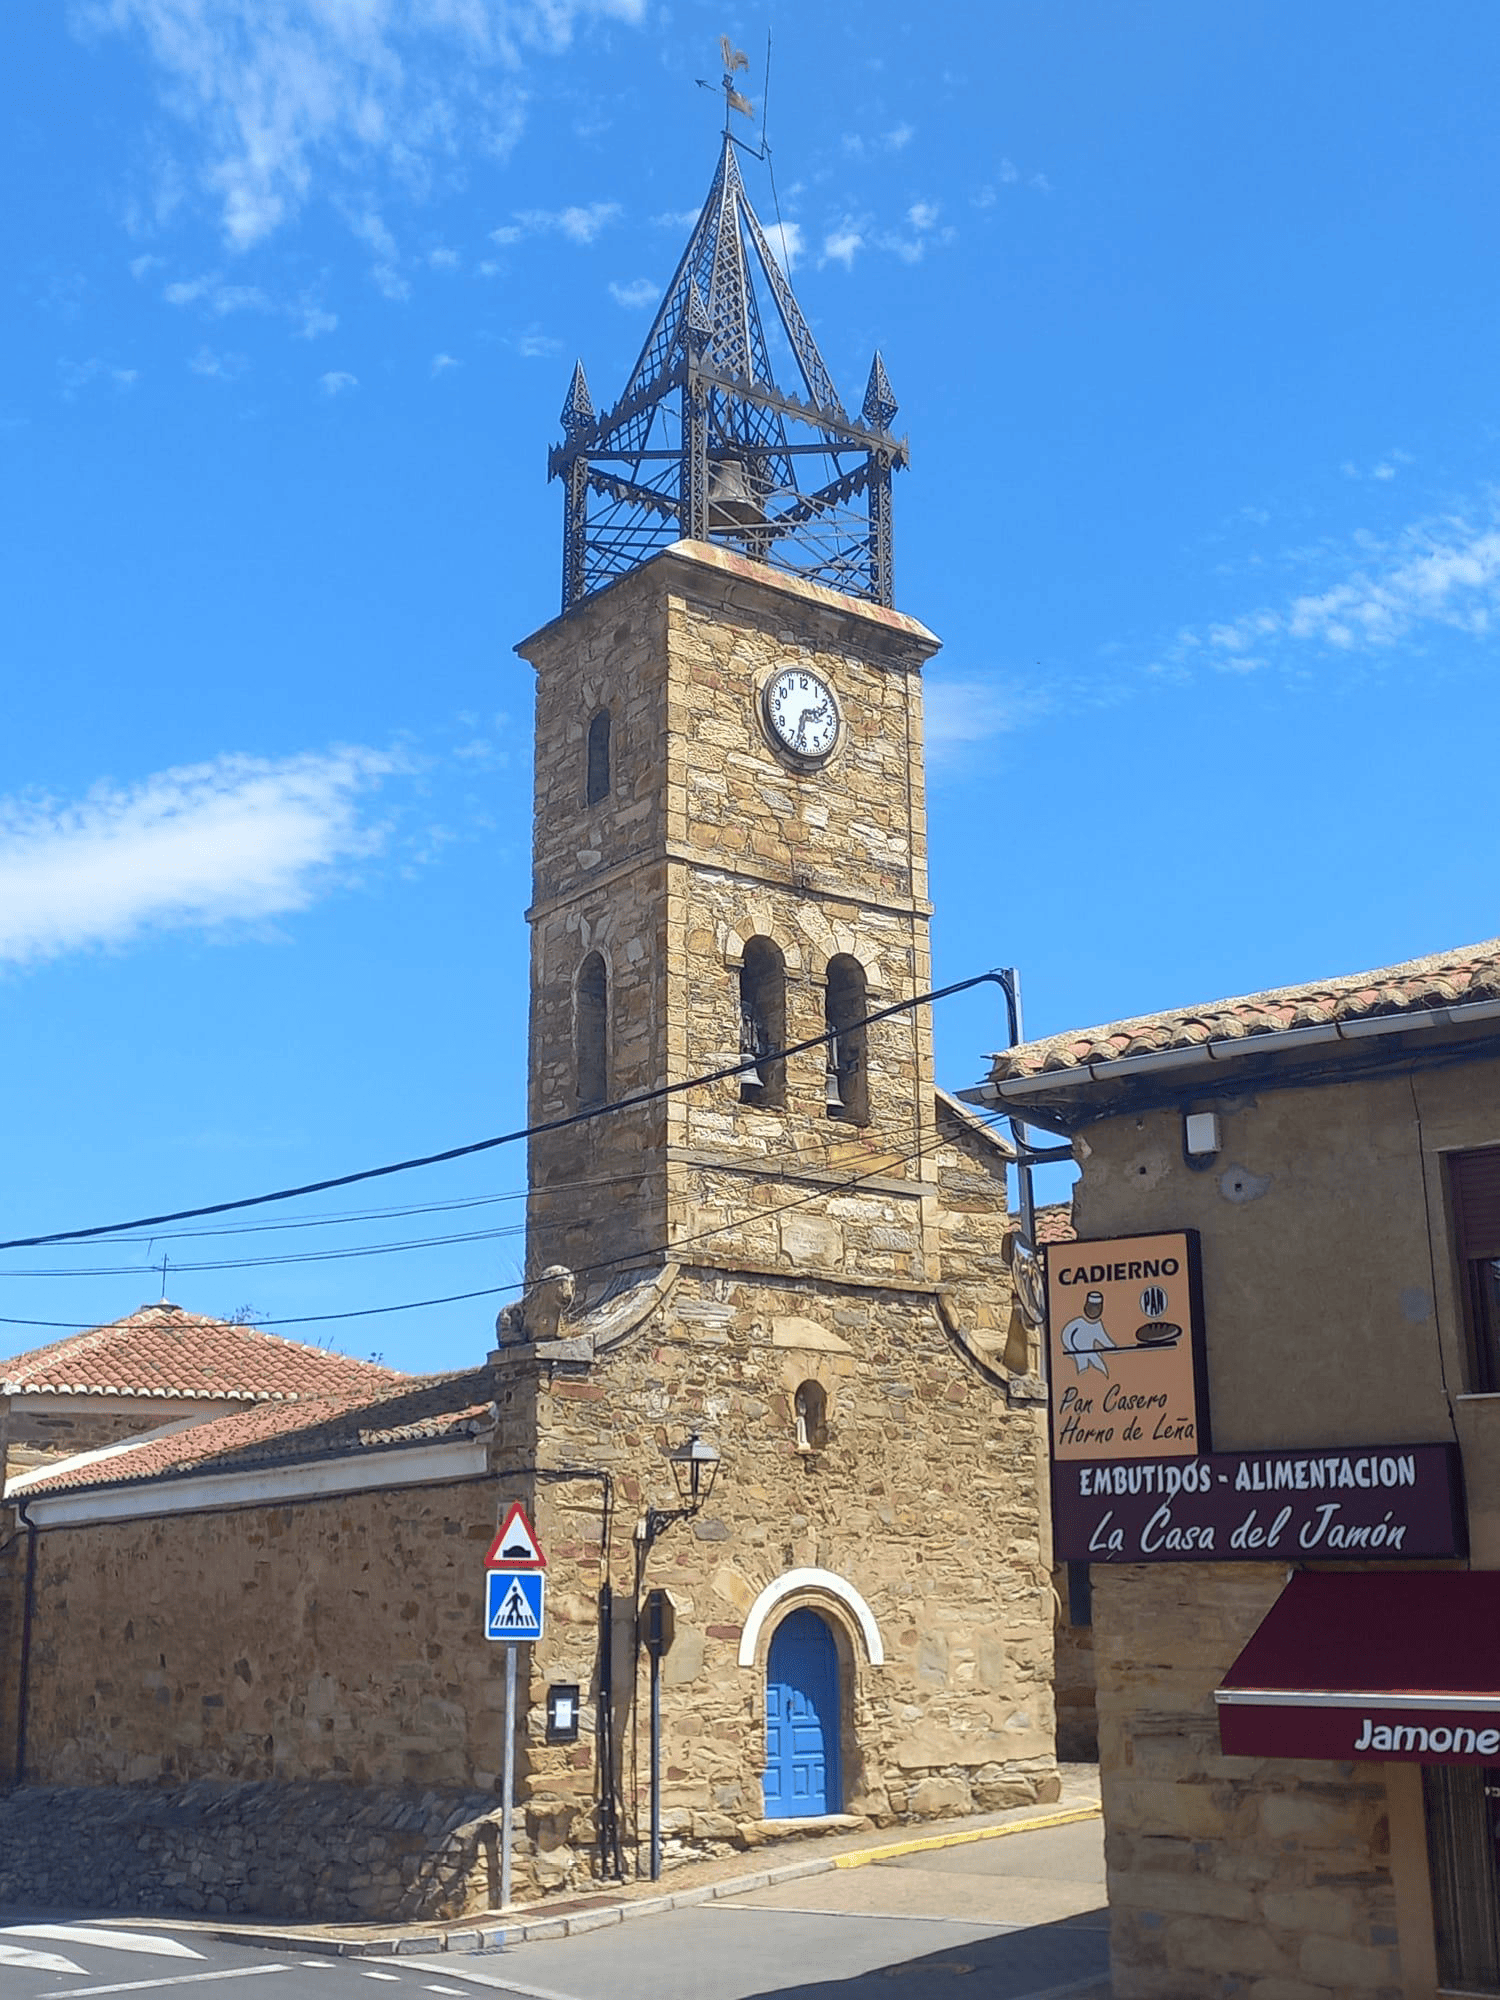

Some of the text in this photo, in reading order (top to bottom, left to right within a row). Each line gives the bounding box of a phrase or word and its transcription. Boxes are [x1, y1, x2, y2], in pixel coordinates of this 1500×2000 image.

[789, 678, 794, 690] 11
[800, 677, 808, 690] 12
[779, 687, 787, 699] 10
[775, 699, 781, 710] 9
[822, 699, 828, 710] 2
[779, 715, 785, 726] 8
[826, 715, 832, 726] 3
[789, 729, 795, 740] 7
[823, 728, 828, 739] 4
[801, 736, 807, 747] 6
[814, 736, 820, 747] 5
[1058, 1258, 1179, 1285] CADIERNO
[1144, 1287, 1164, 1315] PAN
[1059, 1384, 1168, 1415] Pan Casero
[1059, 1413, 1194, 1445] Horno de Leña
[1080, 1464, 1212, 1495] EMBUTIDOS
[1235, 1455, 1416, 1491] ALIMENTACION
[1089, 1503, 1407, 1553] La Casa del Jamón
